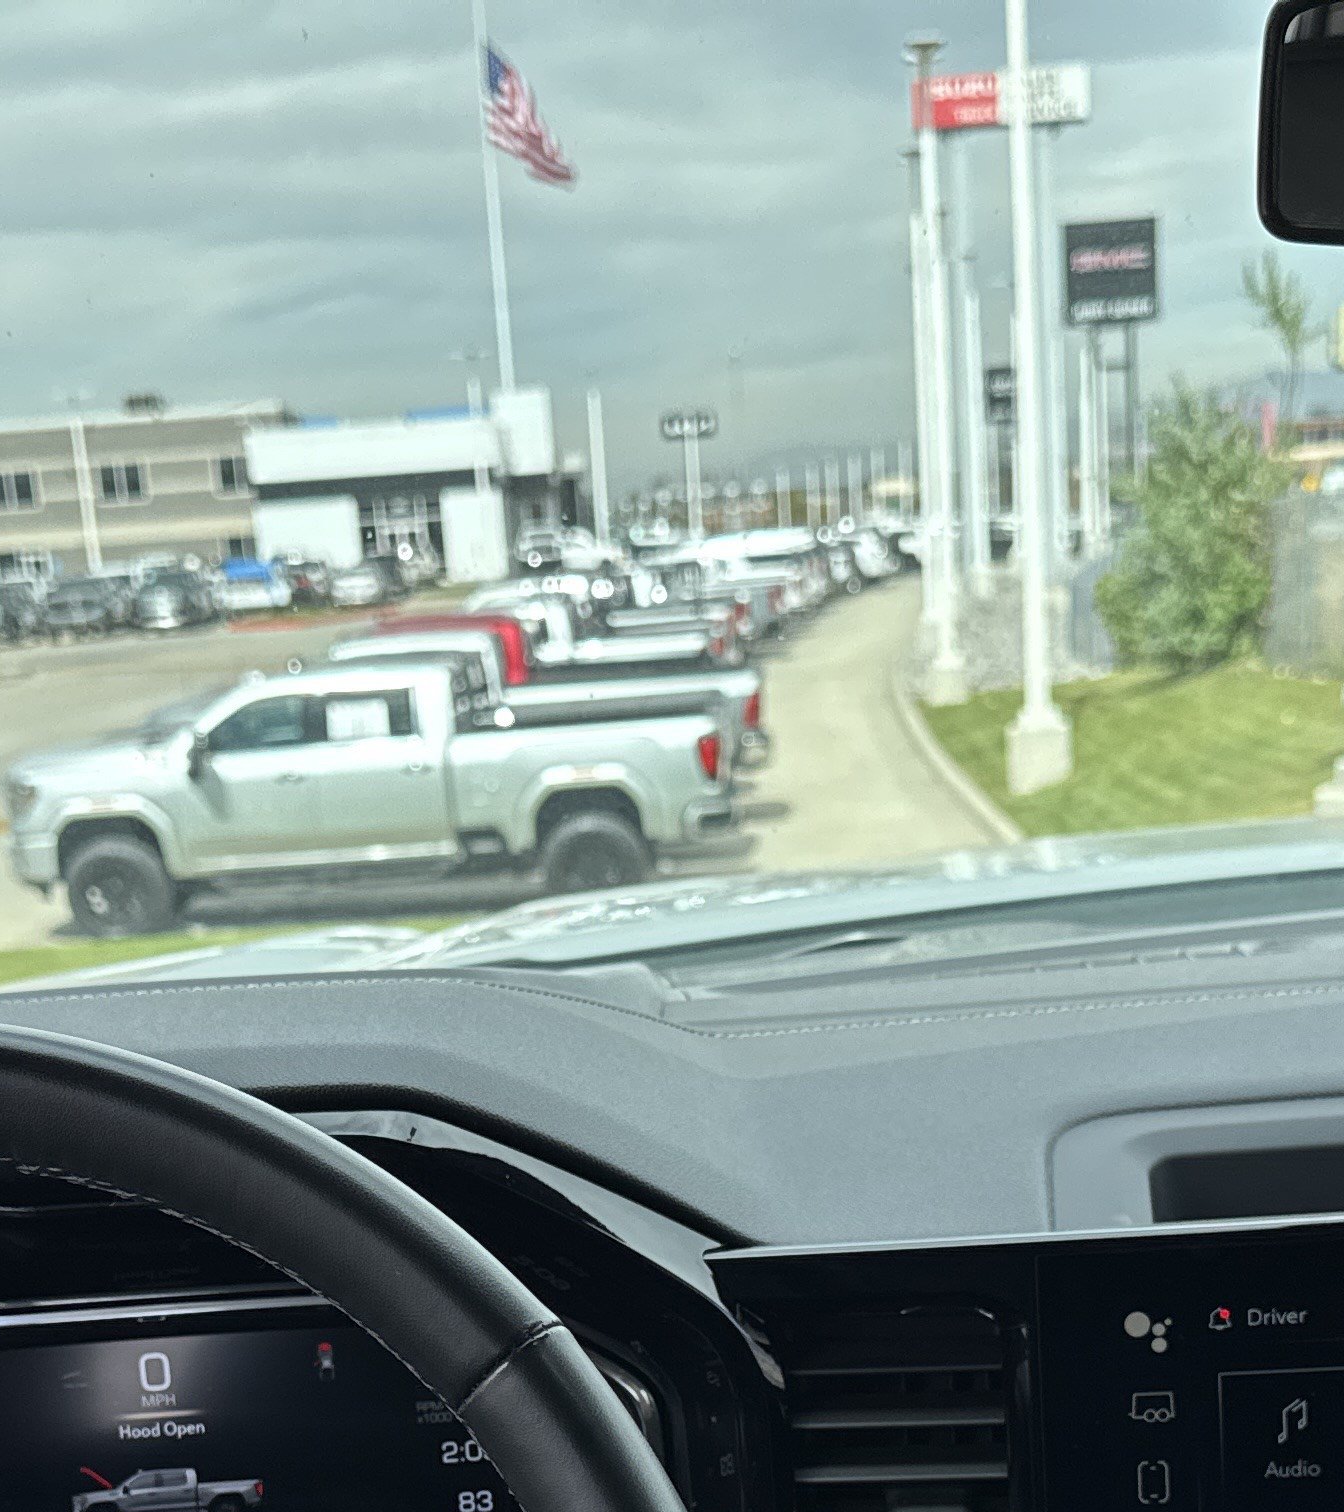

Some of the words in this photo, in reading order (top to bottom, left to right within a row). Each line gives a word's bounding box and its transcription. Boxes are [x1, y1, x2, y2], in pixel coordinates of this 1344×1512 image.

[1248, 1305, 1307, 1326] Driver
[138, 1351, 172, 1392] 0
[140, 1394, 176, 1407] MPH
[118, 1423, 161, 1440] Hood
[164, 1420, 206, 1440] Open
[1265, 1460, 1321, 1480] Audio
